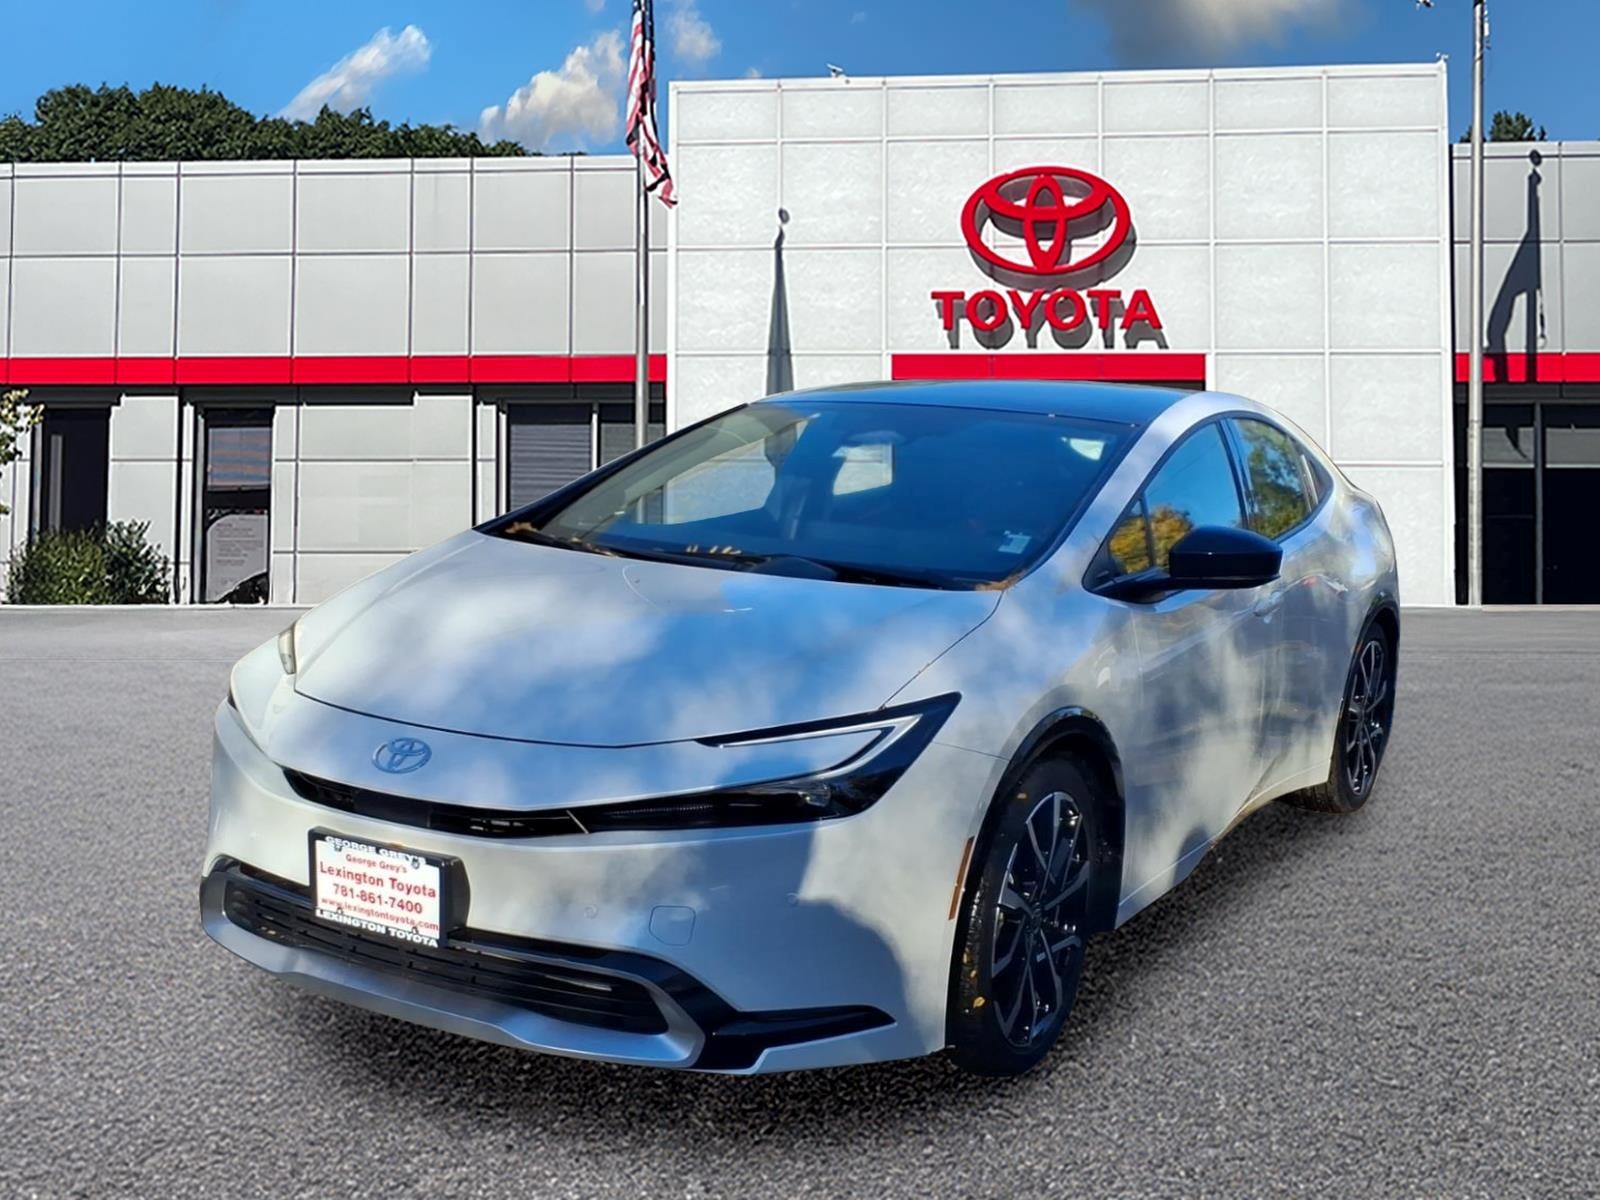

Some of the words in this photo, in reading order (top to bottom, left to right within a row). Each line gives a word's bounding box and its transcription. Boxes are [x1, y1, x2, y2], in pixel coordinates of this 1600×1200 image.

[931, 288, 1163, 330] TOYOTA
[319, 861, 384, 888] Lexington
[389, 877, 436, 899] Toyota
[345, 854, 377, 867] George
[379, 861, 407, 873] Grey's
[333, 883, 423, 914] 781-861-7400
[315, 909, 387, 934] LEXINGTON
[387, 928, 438, 948] TOYOTA
